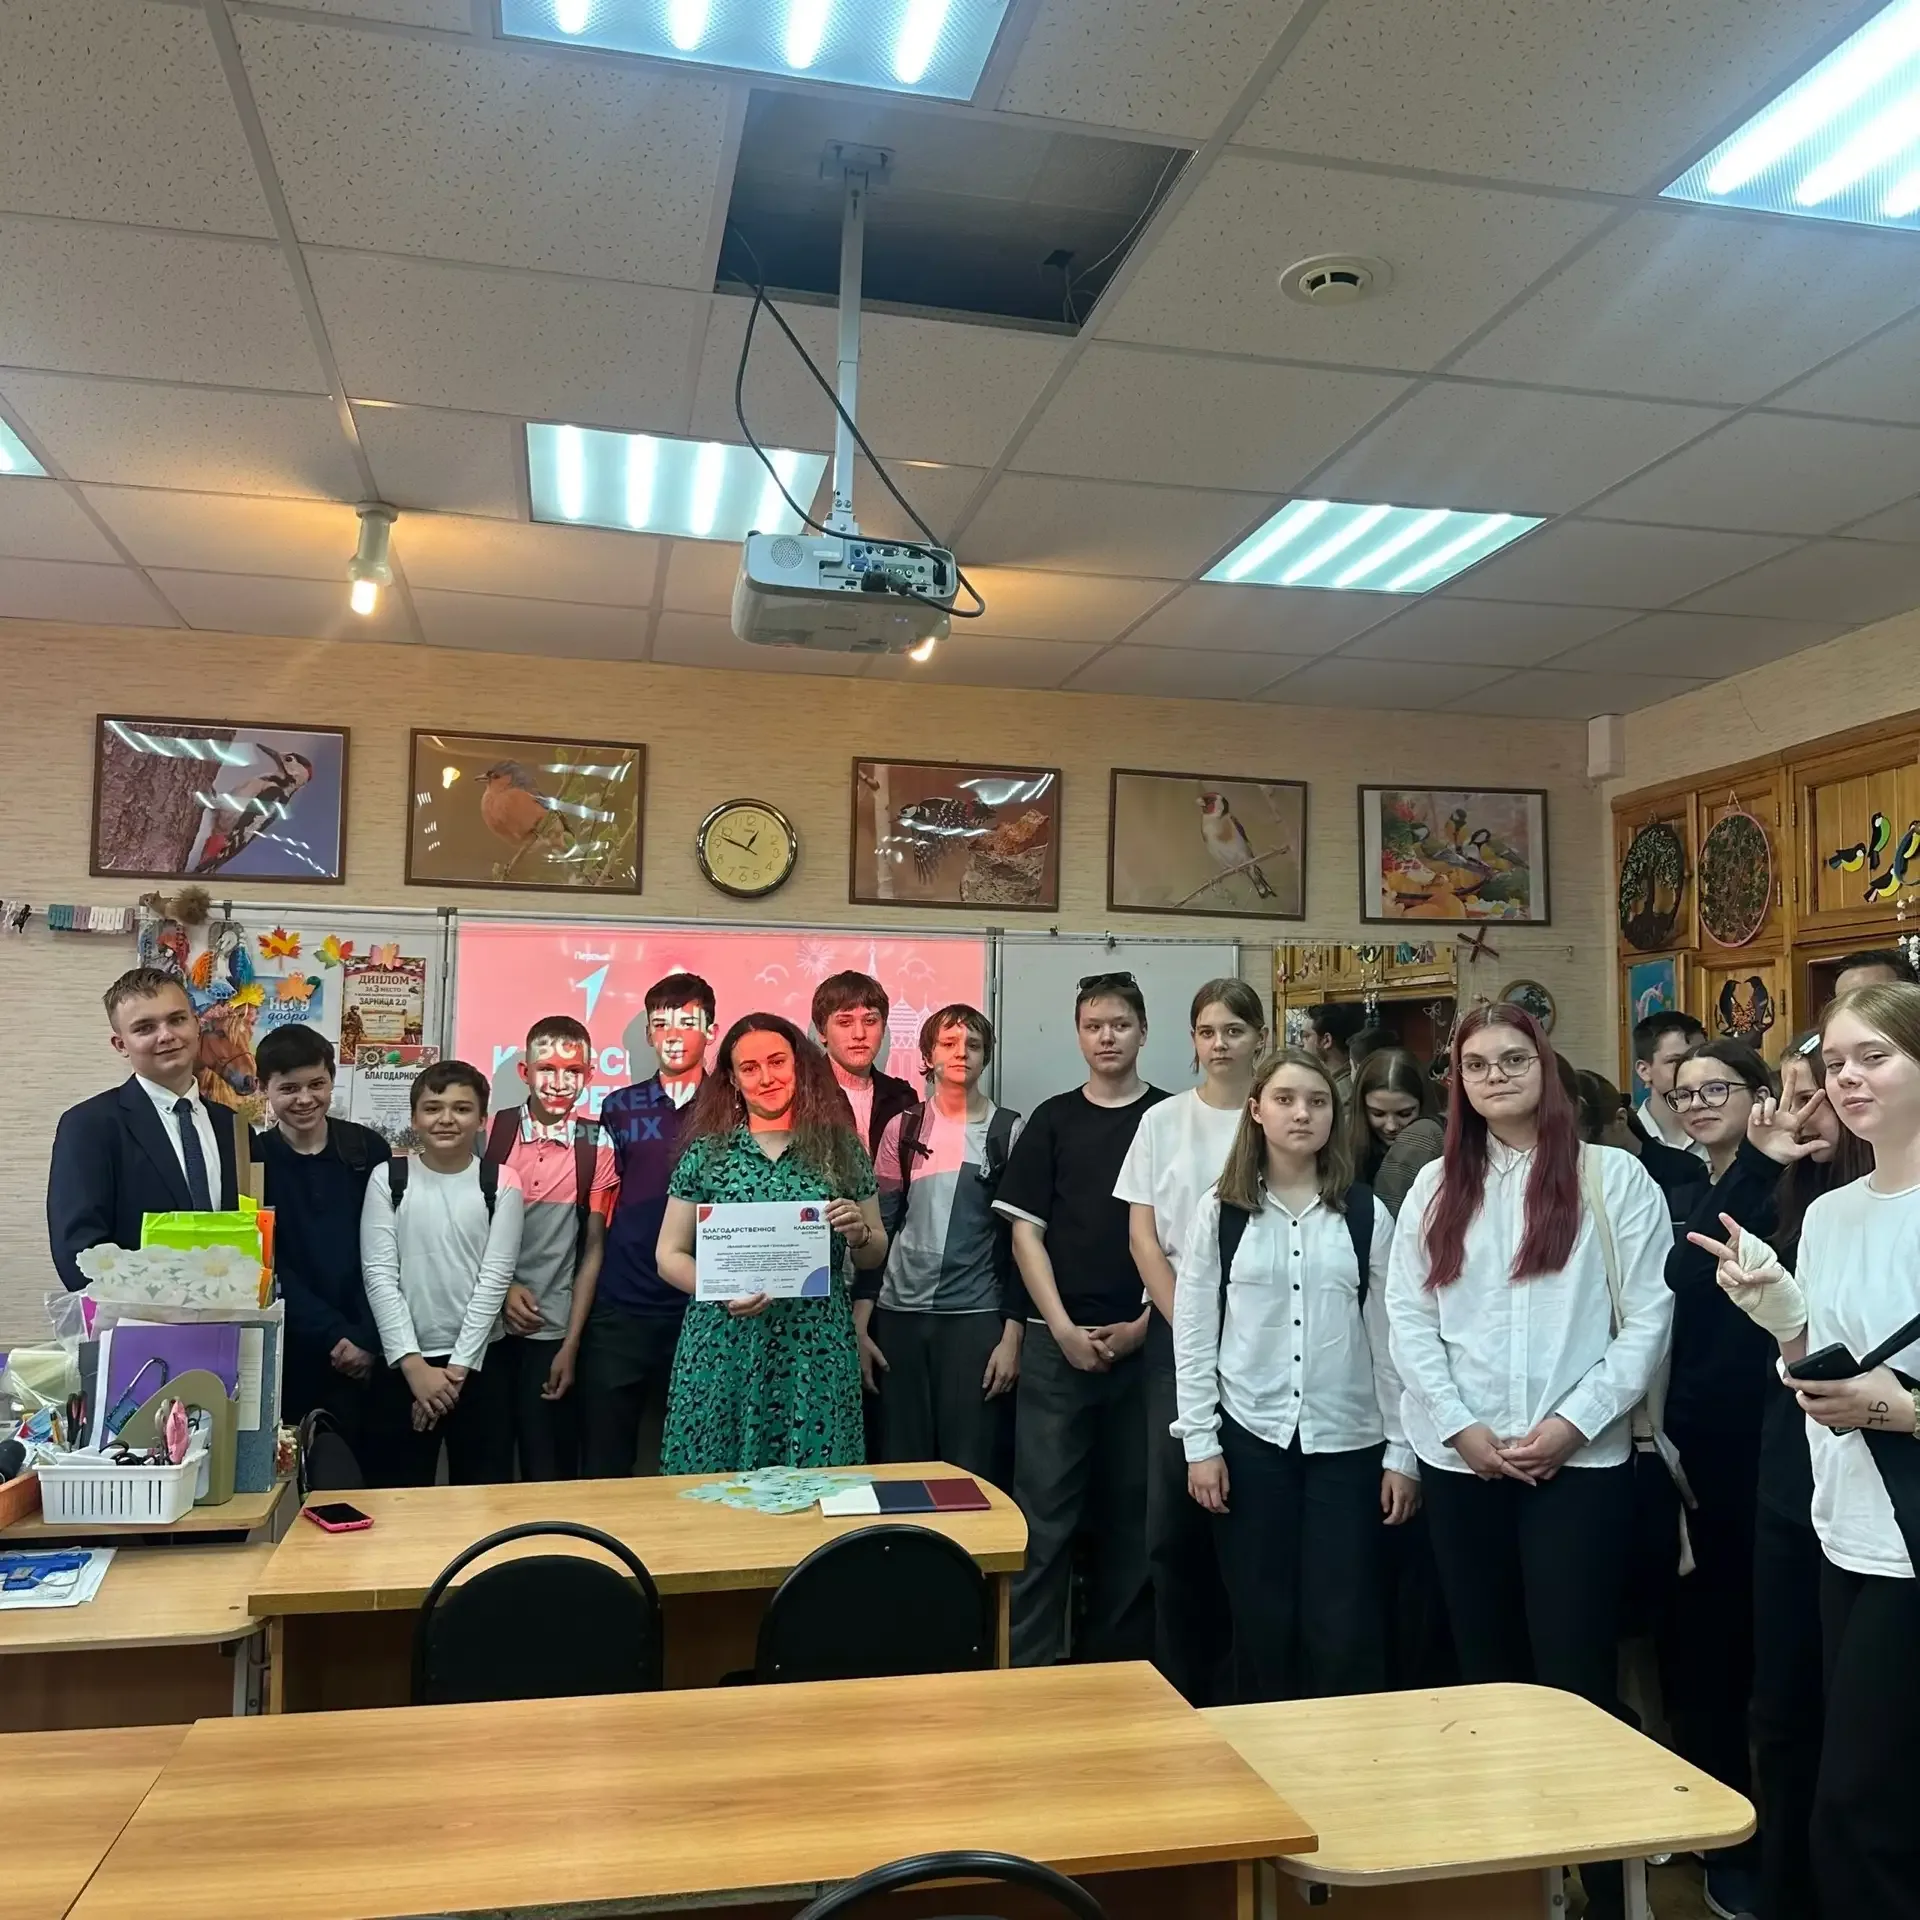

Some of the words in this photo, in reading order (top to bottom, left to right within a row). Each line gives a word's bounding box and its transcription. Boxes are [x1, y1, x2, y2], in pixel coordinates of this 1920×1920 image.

[747, 815, 757, 826] 12
[770, 835, 778, 846] 2
[716, 854, 724, 865] 8
[765, 861, 773, 871] 4
[728, 866, 736, 877] 7
[752, 870, 760, 880] 5
[739, 871, 748, 883] 6
[358, 975, 409, 985] ДИПЛОМ
[359, 998, 394, 1006] ЗАРНИЦА
[395, 998, 408, 1006] 2.0
[364, 1071, 419, 1081] БЛАГОДАРНОС
[702, 1226, 776, 1234] БЛАГОДАРСТВЕННОЕ
